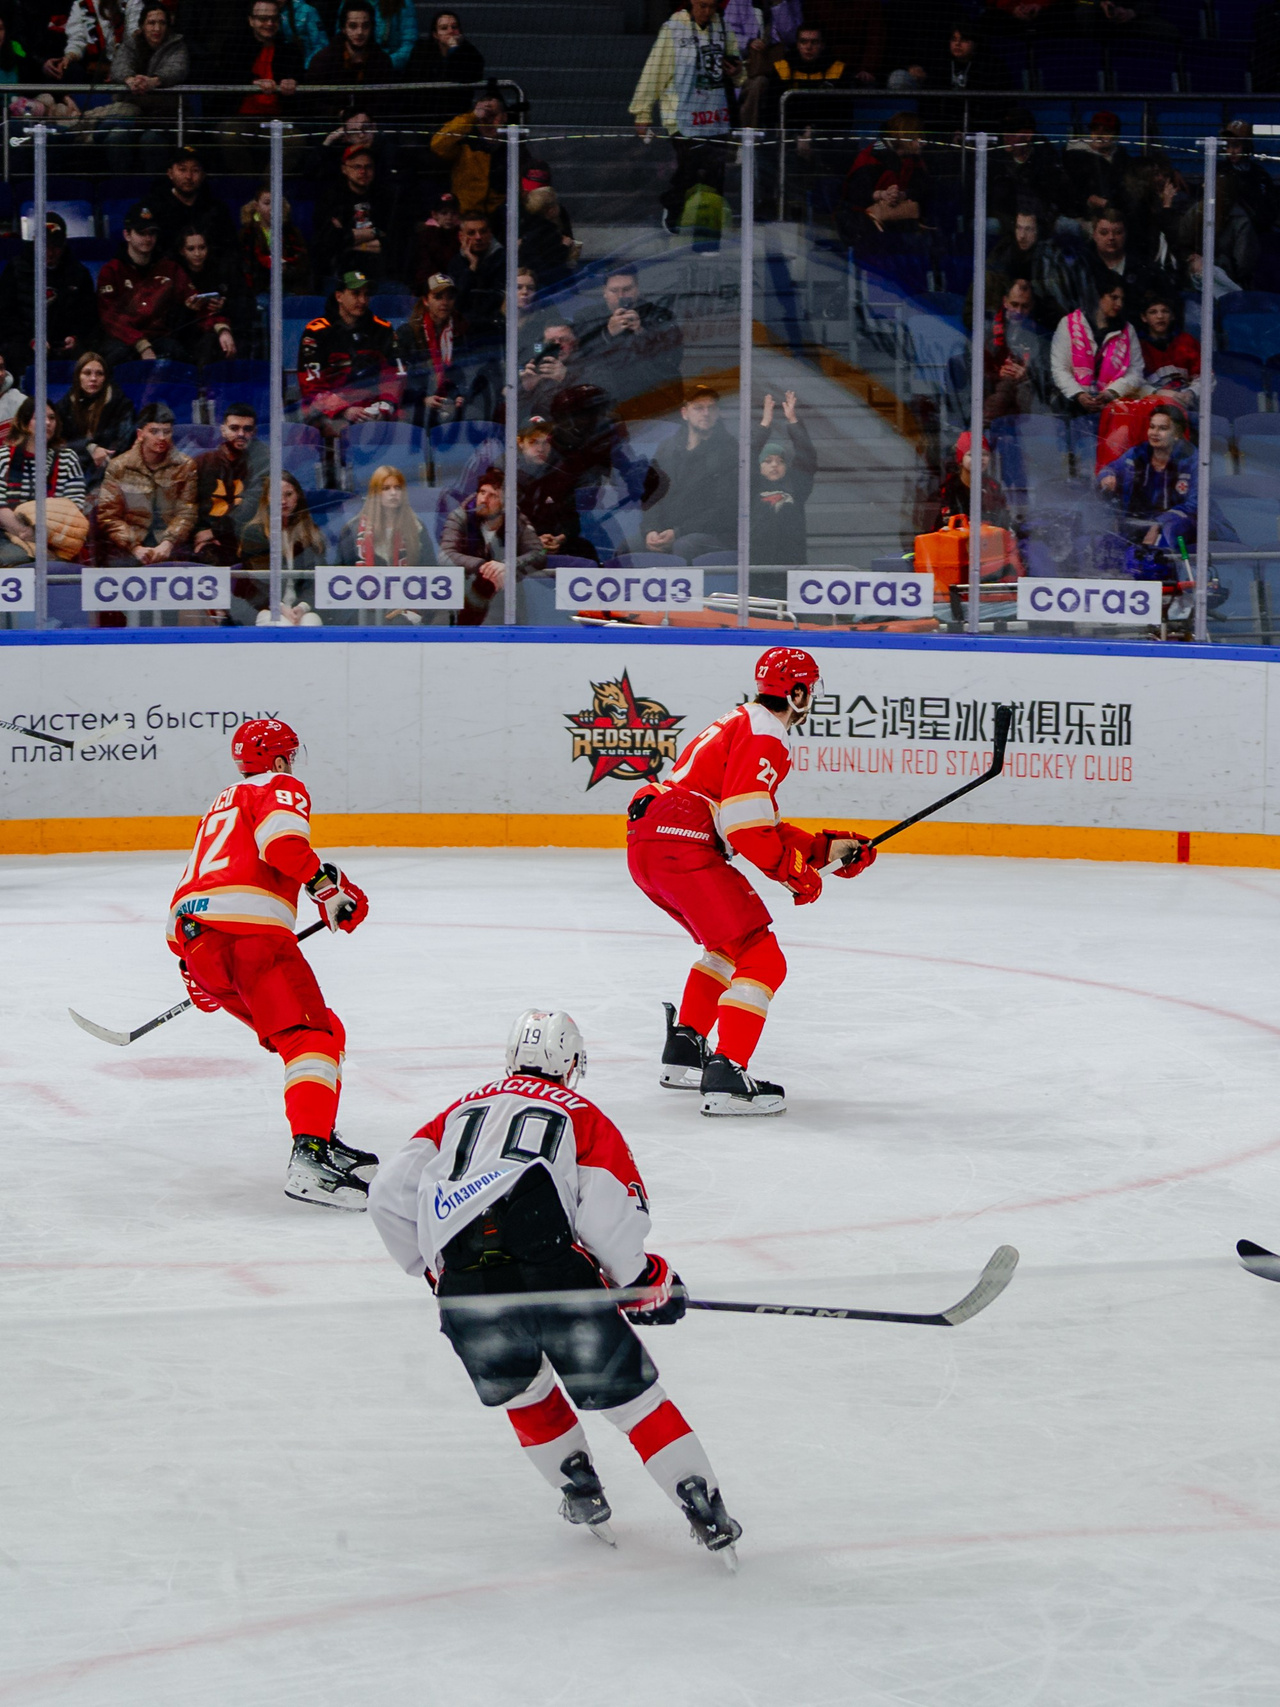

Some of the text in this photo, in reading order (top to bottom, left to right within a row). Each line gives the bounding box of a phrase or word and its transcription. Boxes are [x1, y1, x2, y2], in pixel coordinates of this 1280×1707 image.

[567, 728, 683, 762] REDSTAR
[756, 757, 778, 791] 27
[818, 746, 893, 774] KUNLUN
[902, 748, 938, 775] RED
[946, 750, 994, 776] STAR
[1002, 752, 1077, 780] HOCKEY
[1085, 754, 1133, 782] CLUB
[274, 789, 308, 817] 92
[656, 825, 710, 841] WARRIOR
[522, 1027, 542, 1045] 19
